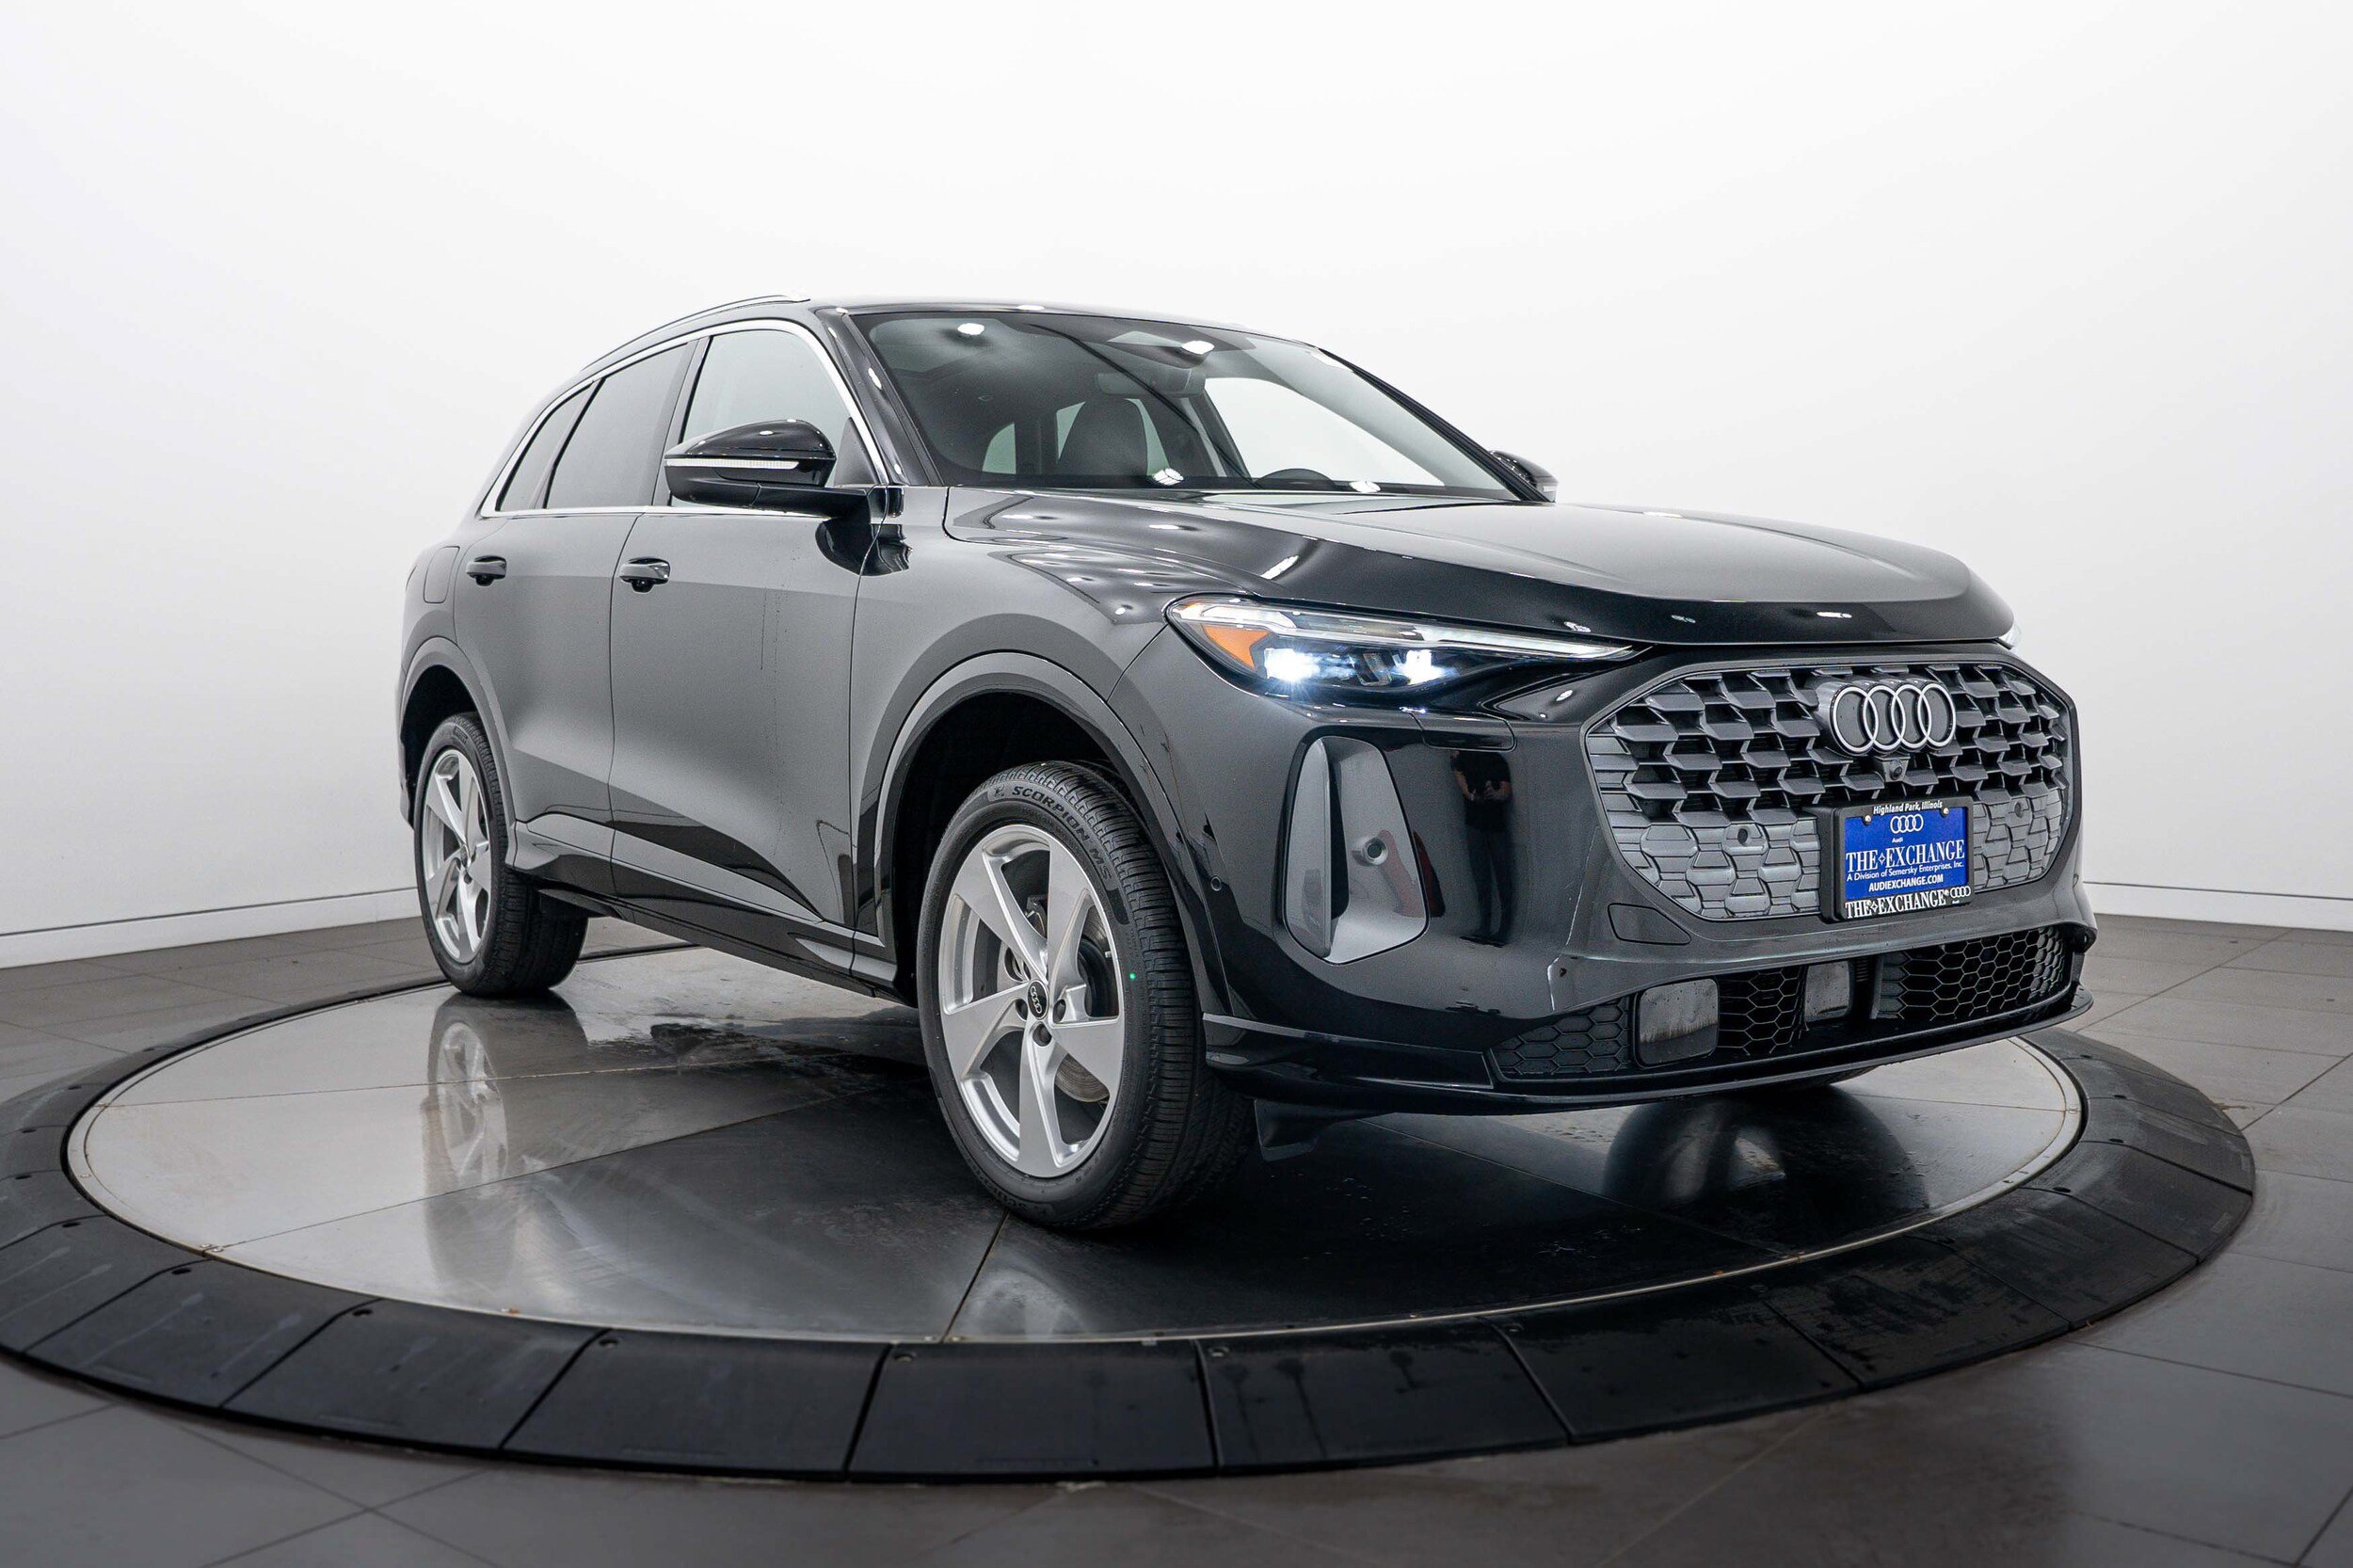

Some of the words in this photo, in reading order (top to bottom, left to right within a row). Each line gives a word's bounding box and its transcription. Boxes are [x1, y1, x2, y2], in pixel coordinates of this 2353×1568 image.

[1012, 786, 1090, 840] SCORPION
[1873, 803, 1904, 816] Highland
[1904, 802, 1921, 811] Park,
[1921, 800, 1943, 809] Illinois
[1846, 849, 1879, 872] THE
[1885, 840, 1965, 868] EXCHANGE
[1847, 872, 1853, 882] A
[1854, 872, 1880, 881] Division
[1881, 869, 1888, 877] of
[1953, 860, 1964, 869] Inc.
[1868, 873, 1944, 892] AUDIEXCHANGE.COM
[1845, 899, 1873, 919] THE
[1877, 889, 1946, 915] EXCHANGE
